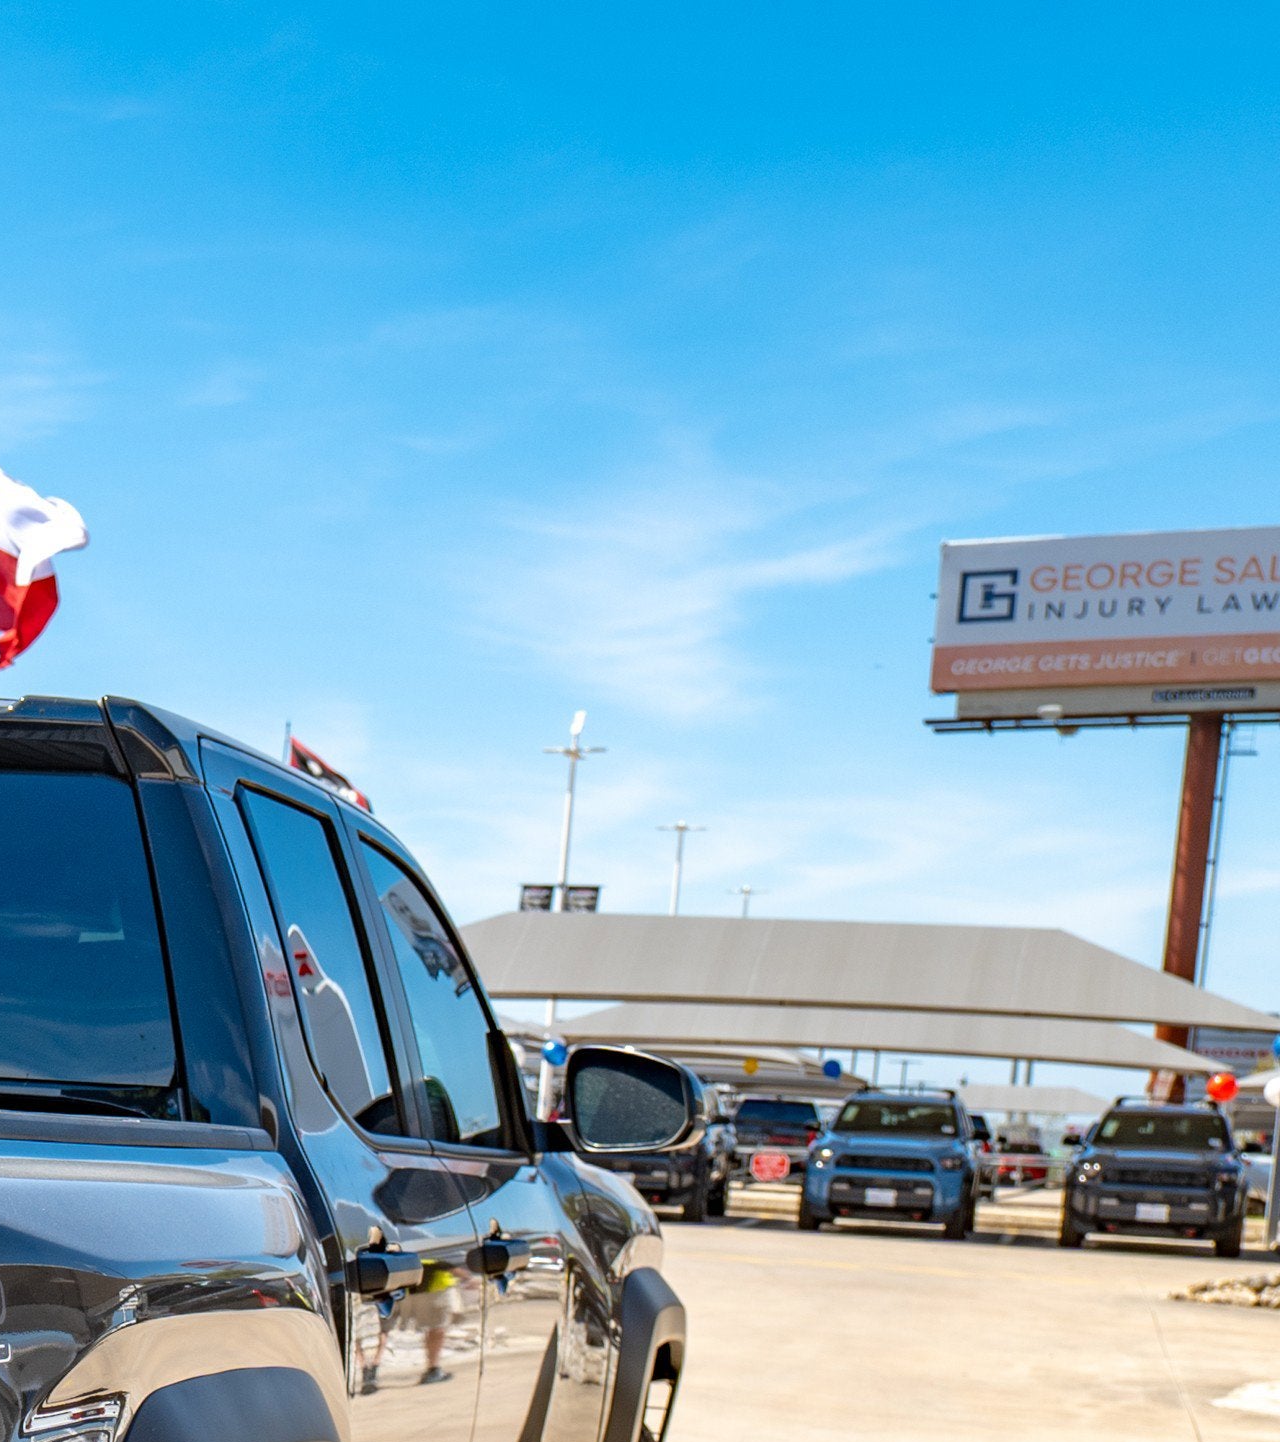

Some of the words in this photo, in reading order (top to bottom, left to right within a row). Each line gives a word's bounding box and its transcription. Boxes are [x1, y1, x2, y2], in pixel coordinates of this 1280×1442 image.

[1030, 558, 1202, 593] GEORGE
[1028, 597, 1172, 621] INJURY
[1197, 591, 1280, 615] LAW
[951, 656, 1035, 676] GEORGE
[1039, 654, 1090, 672] GETS
[1093, 650, 1181, 670] JUSTICE
